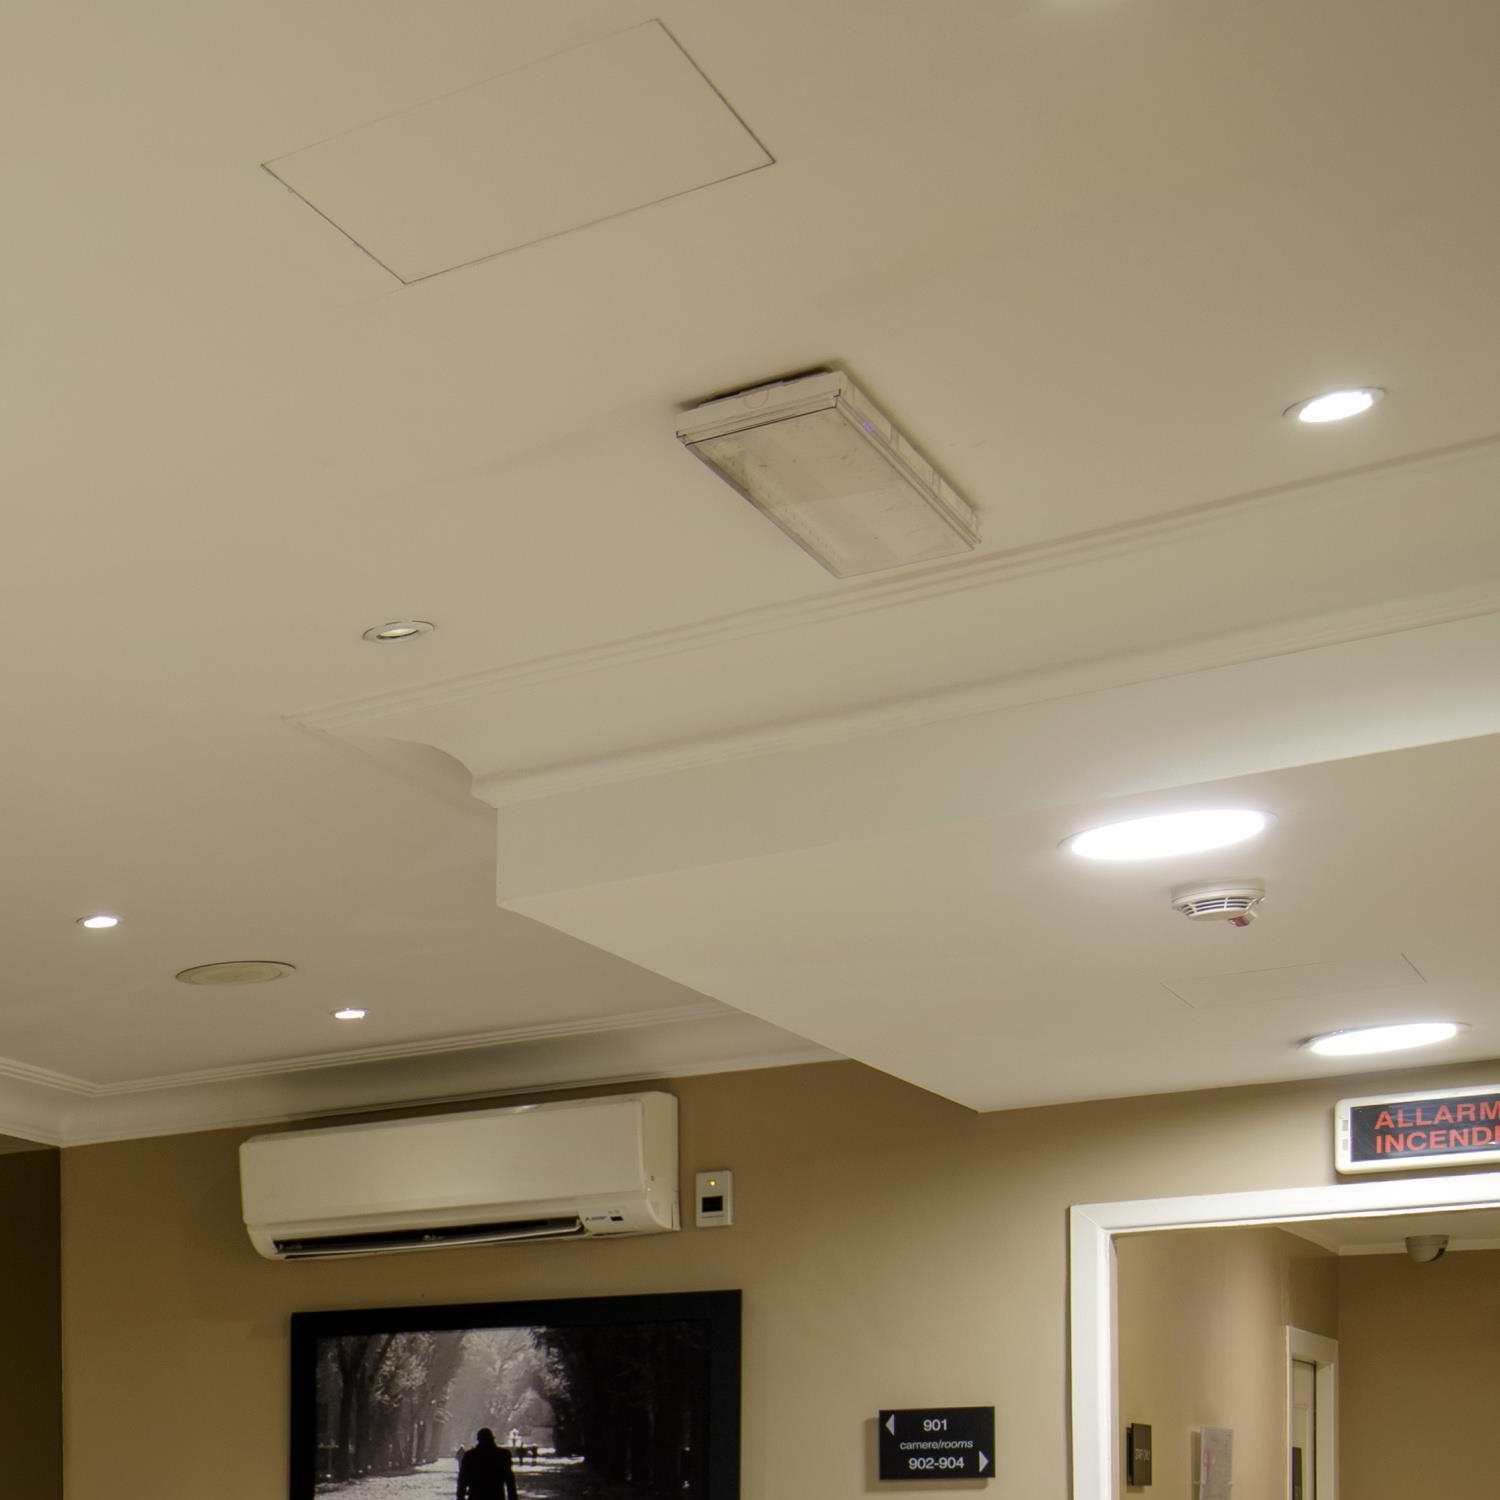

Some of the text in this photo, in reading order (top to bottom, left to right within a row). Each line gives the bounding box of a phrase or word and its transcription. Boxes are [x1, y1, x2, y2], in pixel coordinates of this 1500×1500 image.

[923, 1418, 948, 1432] 901
[899, 1439, 974, 1450] camere/rooms
[908, 1456, 965, 1470] 902-904
